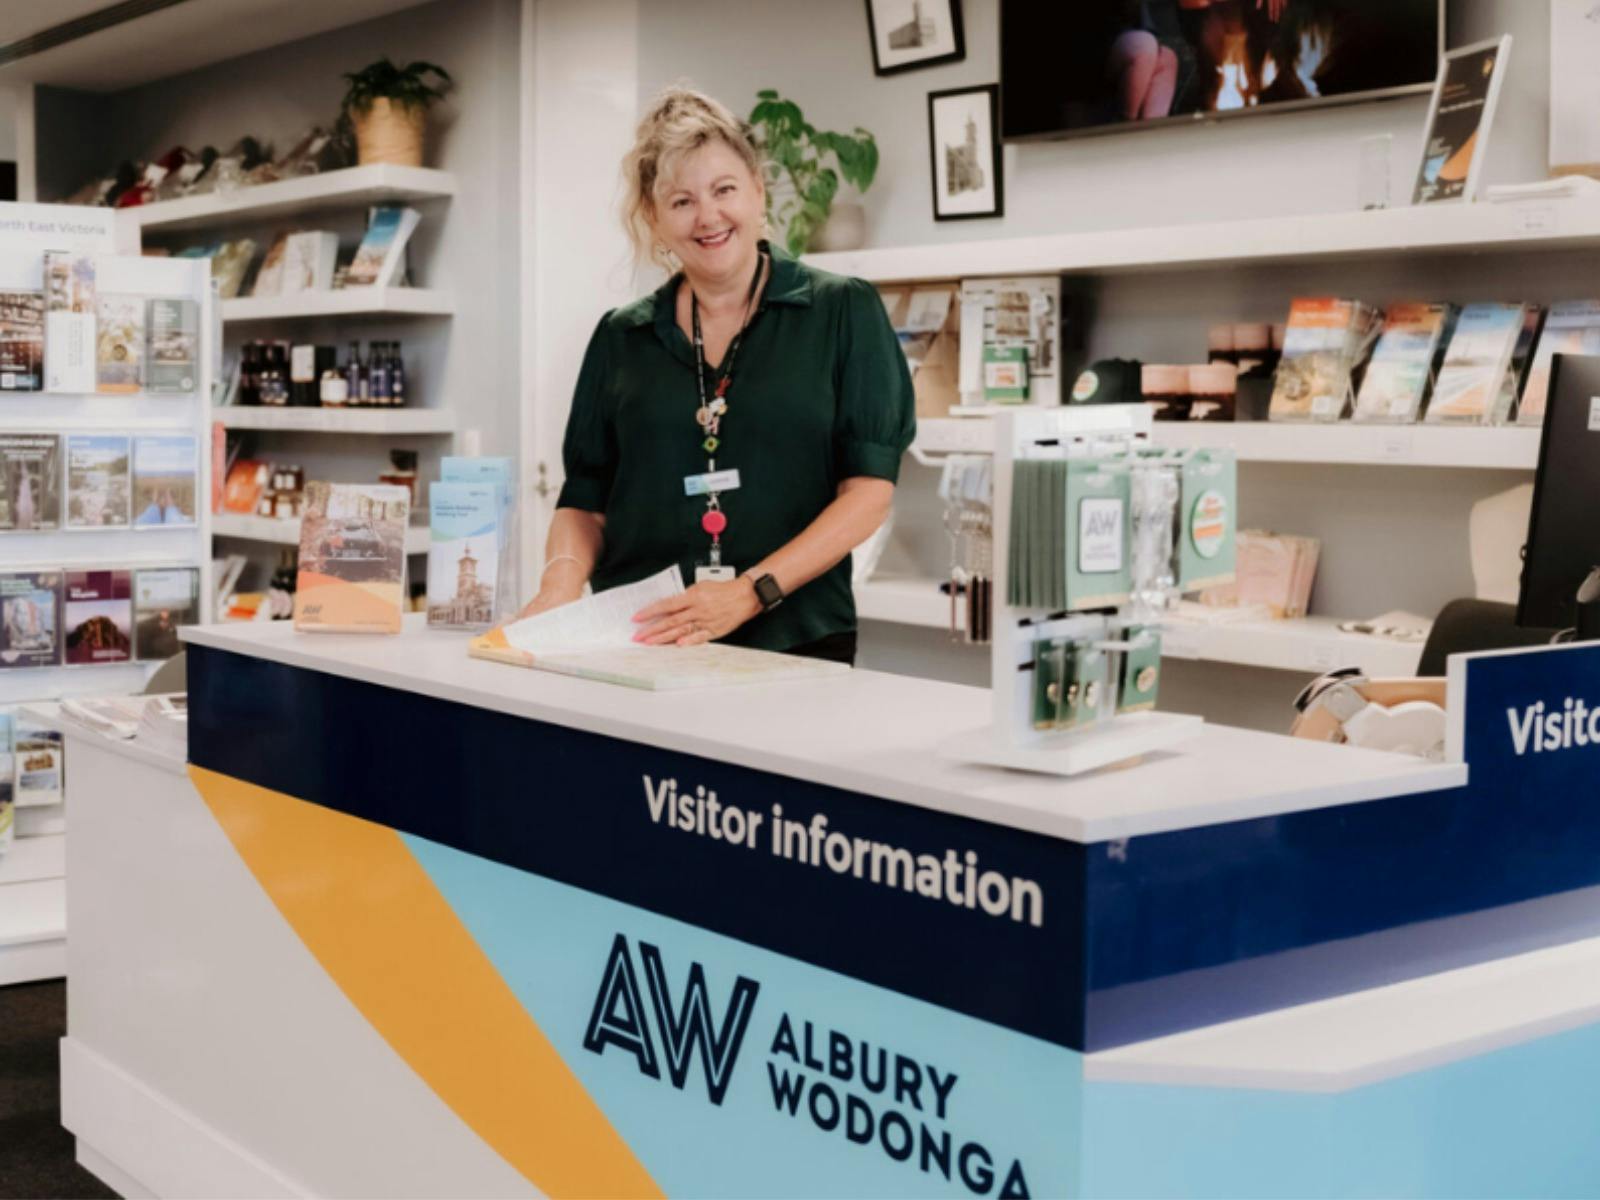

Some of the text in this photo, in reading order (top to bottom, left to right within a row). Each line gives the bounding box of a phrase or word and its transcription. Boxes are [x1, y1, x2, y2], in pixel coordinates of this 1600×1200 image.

[1086, 510, 1118, 537] AW
[642, 775, 1044, 928] Visitor information
[582, 932, 761, 1107] AW
[769, 1012, 958, 1121] ALBURY
[766, 1060, 1031, 1200] WODONGA
